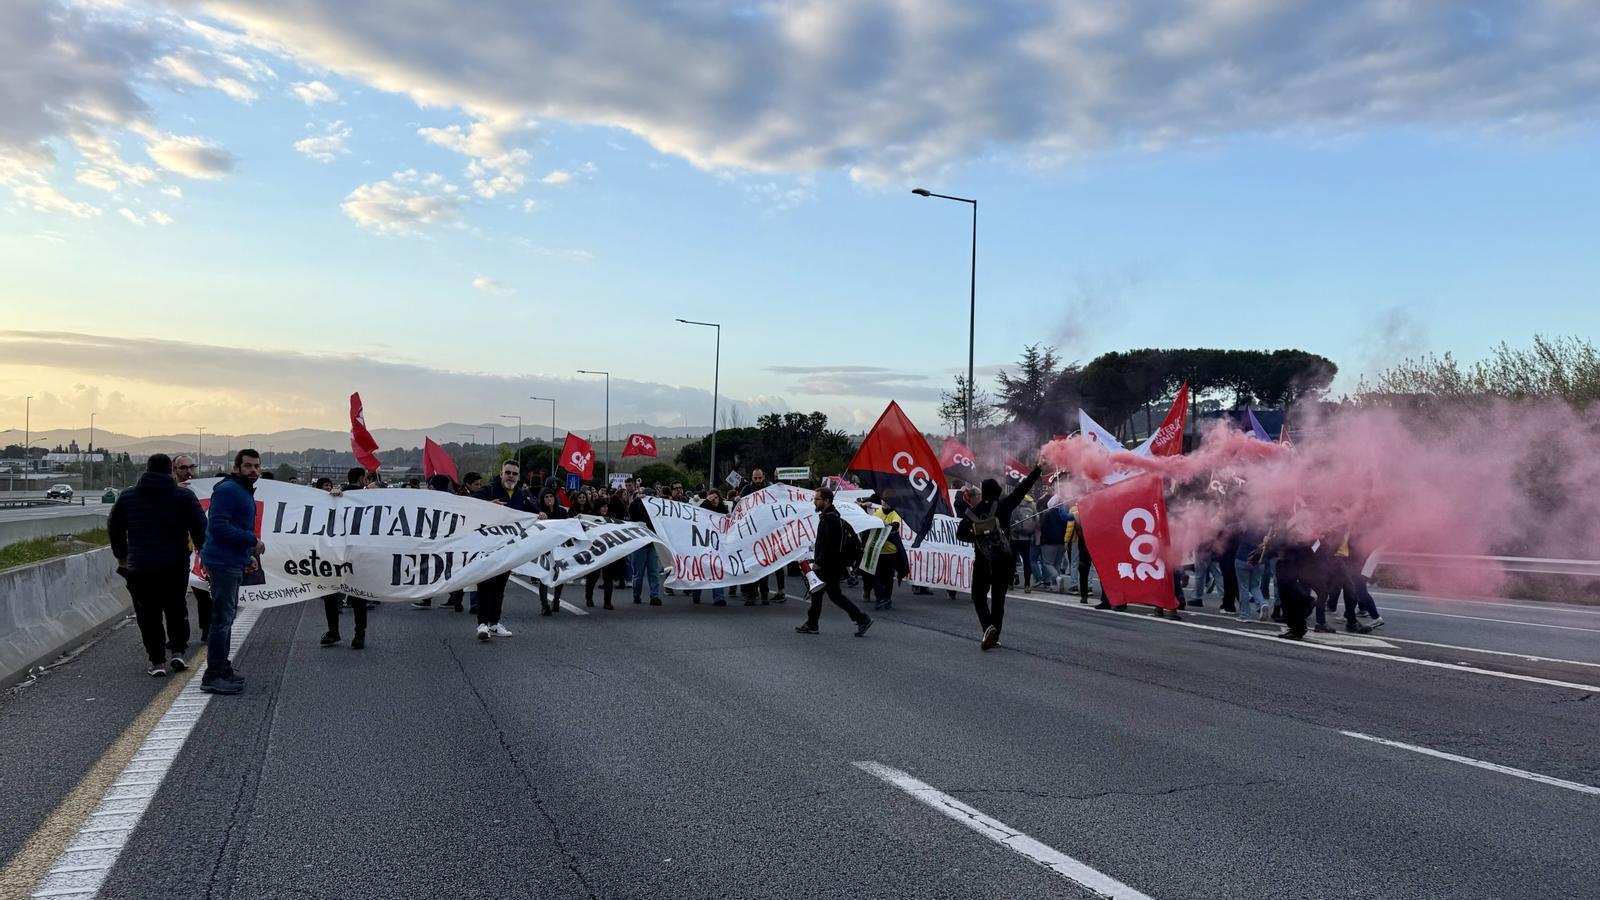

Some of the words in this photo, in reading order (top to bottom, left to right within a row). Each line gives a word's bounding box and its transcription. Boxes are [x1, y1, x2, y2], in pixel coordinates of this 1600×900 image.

[272, 501, 466, 540] LLUITANT
[648, 498, 700, 523] SENSE
[692, 525, 720, 550] NO
[771, 504, 798, 521] HA
[728, 550, 749, 577] DE
